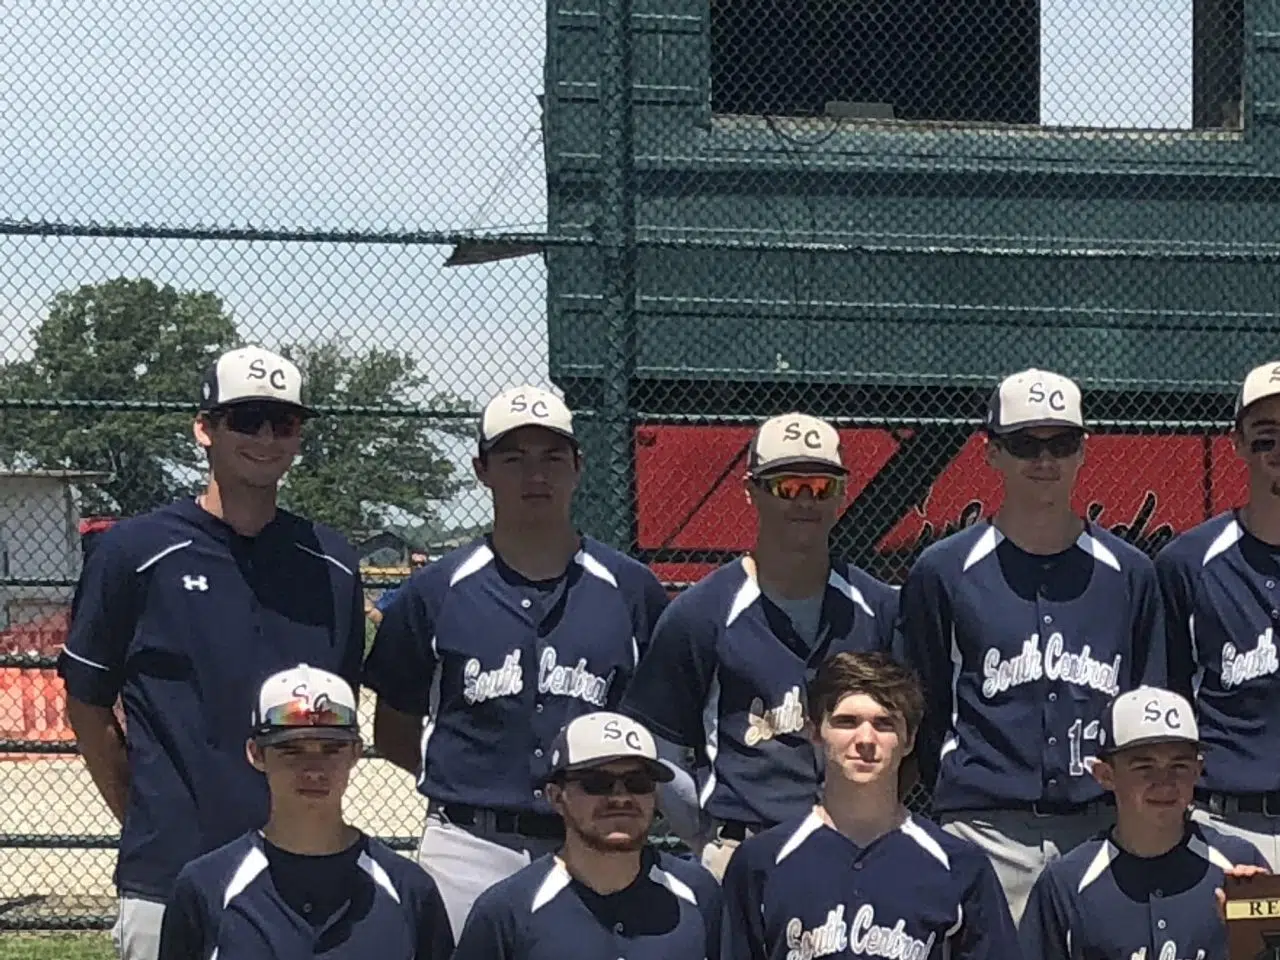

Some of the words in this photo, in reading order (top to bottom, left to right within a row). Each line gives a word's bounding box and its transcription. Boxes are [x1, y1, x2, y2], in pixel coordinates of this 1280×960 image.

[464, 649, 524, 706] South
[538, 646, 616, 707] Central
[982, 633, 1042, 699] South
[1045, 632, 1120, 697] Central
[1221, 628, 1279, 689] South
